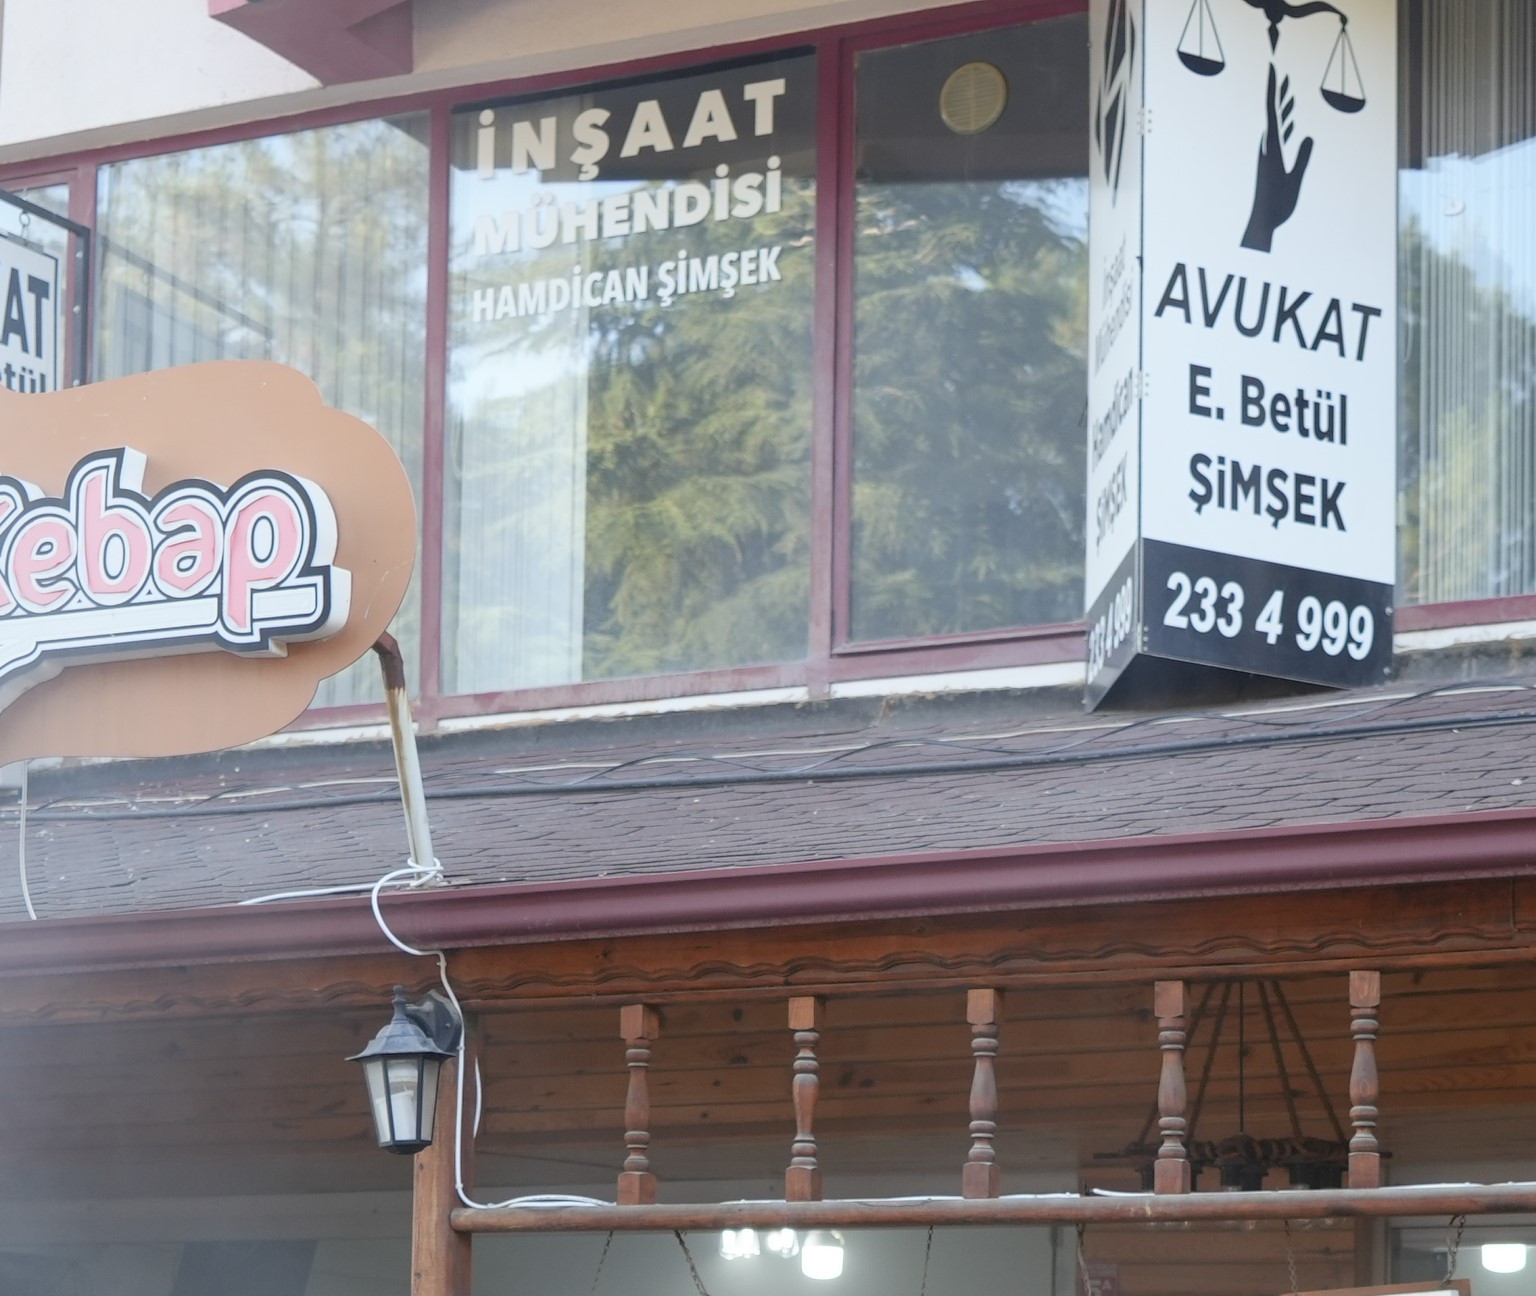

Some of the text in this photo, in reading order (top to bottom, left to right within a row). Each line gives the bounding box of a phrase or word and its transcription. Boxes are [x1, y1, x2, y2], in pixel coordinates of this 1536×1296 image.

[477, 79, 786, 180] İNŞAAT
[473, 156, 782, 256] MÜHENDİSİ
[473, 247, 782, 322] HAMDİCAN ŞİMŞEK
[1155, 262, 1381, 361] AVUKAT
[1189, 365, 1348, 447] E. Betül
[1163, 571, 1373, 661] 233 4 999
